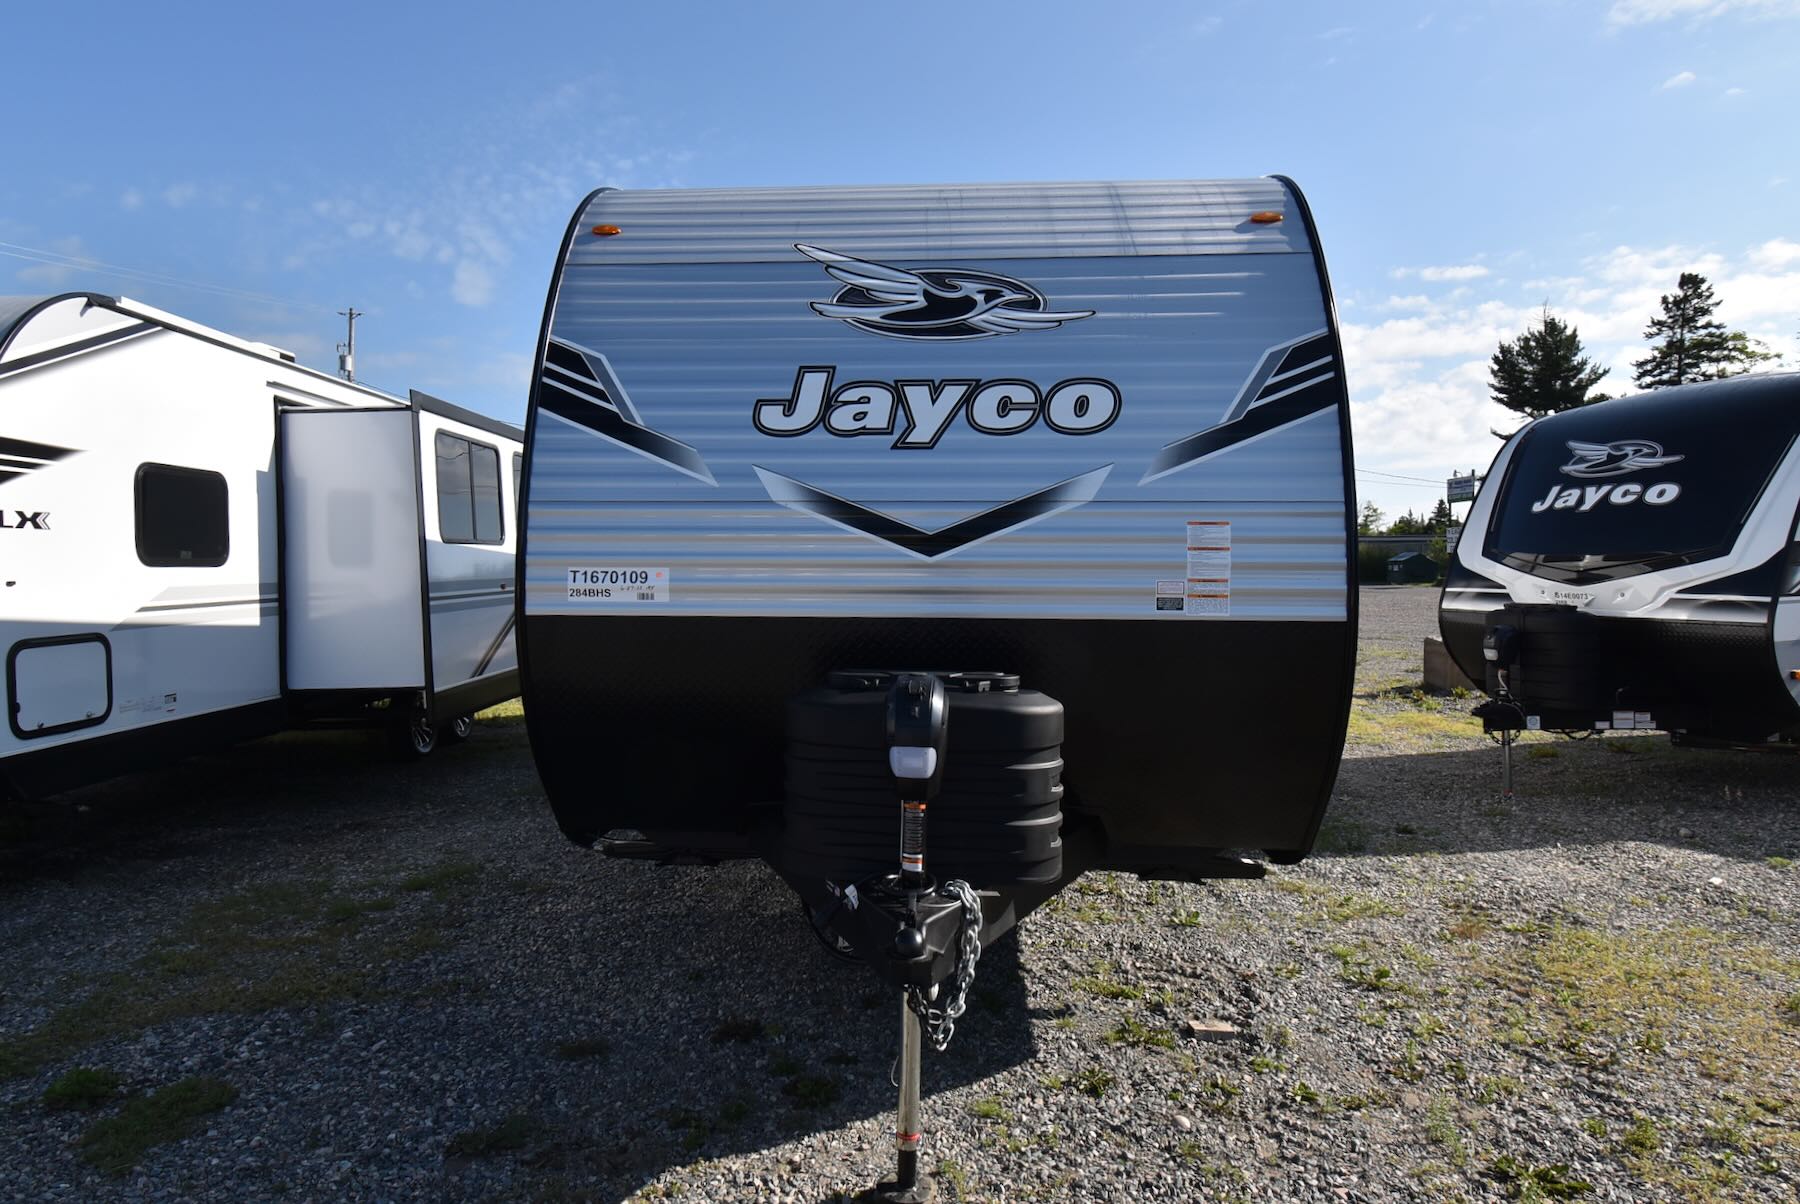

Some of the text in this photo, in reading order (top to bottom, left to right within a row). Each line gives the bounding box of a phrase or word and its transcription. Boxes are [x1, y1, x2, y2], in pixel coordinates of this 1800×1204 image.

[752, 365, 1122, 449] Jayco
[1531, 483, 1681, 513] Jayco
[569, 569, 649, 585] T1670109
[569, 588, 612, 598] 284BHS
